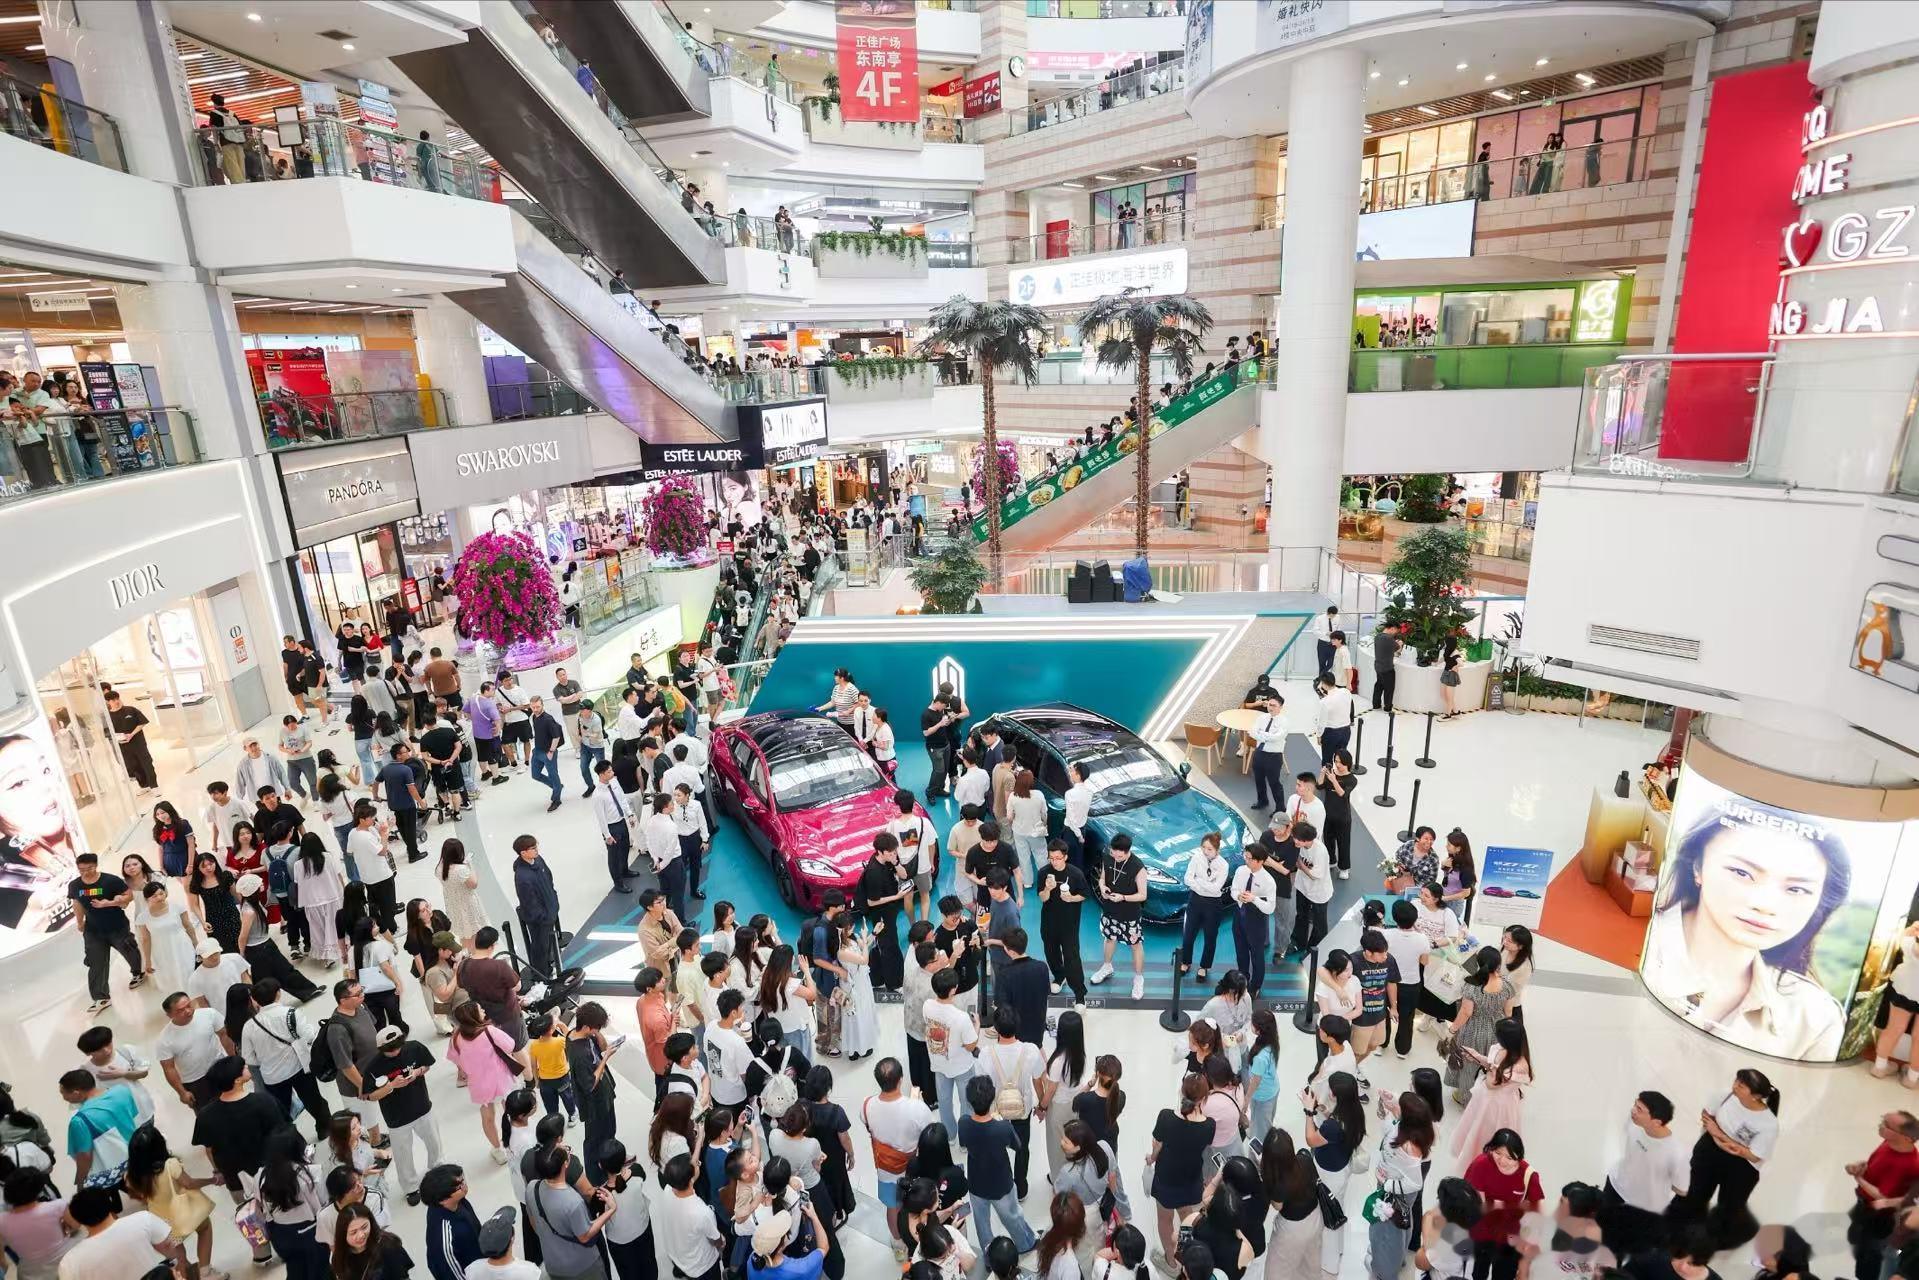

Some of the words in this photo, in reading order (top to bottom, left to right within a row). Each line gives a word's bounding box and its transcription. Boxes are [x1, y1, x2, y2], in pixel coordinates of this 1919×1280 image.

[855, 35, 902, 49] 正佳广场
[855, 70, 903, 107] 4F
[1827, 205, 1916, 263] GZ
[1812, 296, 1885, 334] JIA
[456, 440, 560, 478] SWAROVSKI
[697, 448, 743, 463] LAUDER
[795, 443, 818, 459] LAUDER
[327, 479, 384, 504] PANDORA
[108, 562, 165, 610] DIOR
